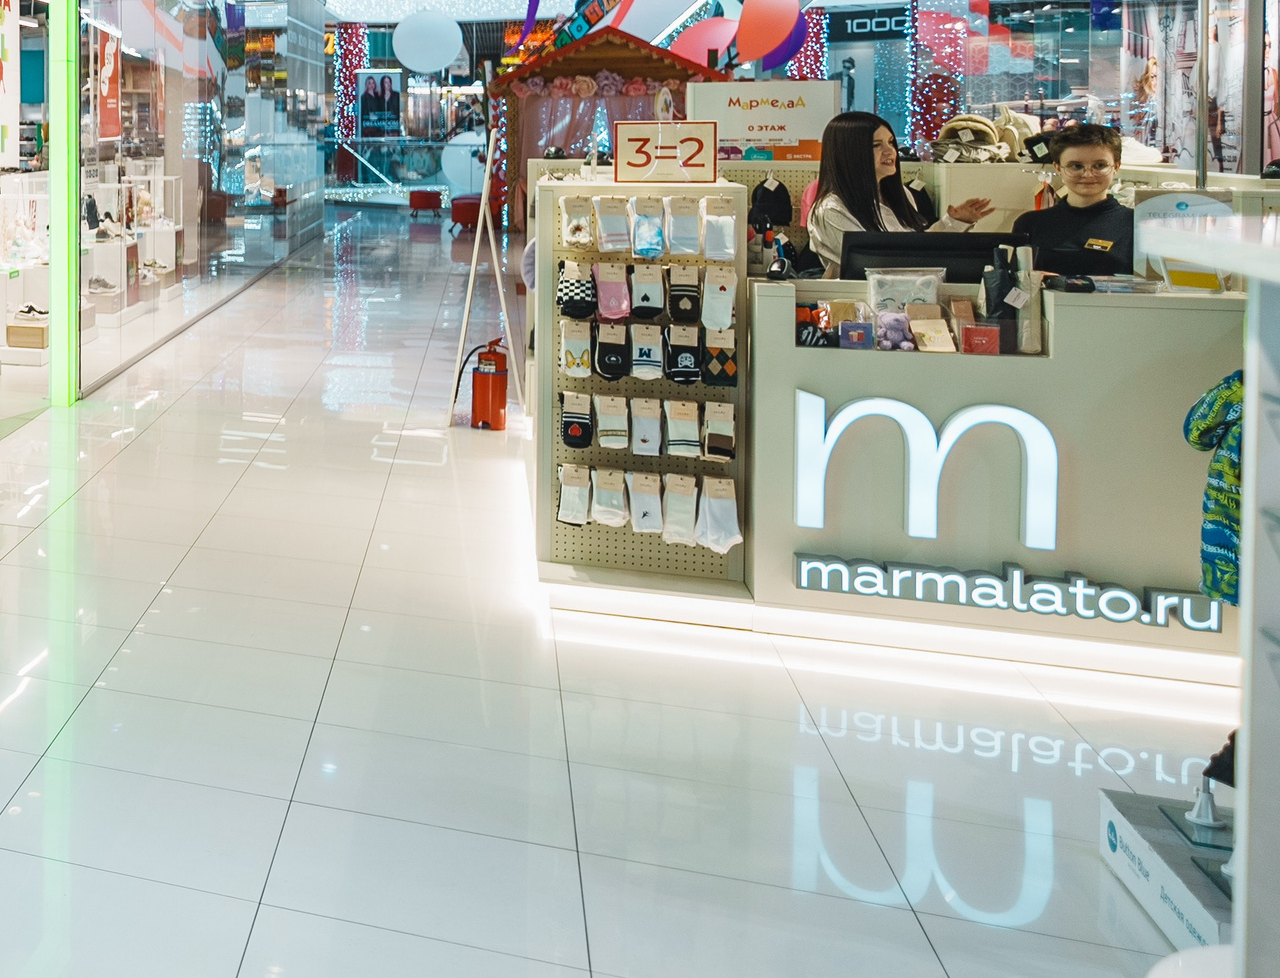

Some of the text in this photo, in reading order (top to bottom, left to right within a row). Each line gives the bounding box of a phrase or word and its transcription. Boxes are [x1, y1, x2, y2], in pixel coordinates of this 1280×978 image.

[757, 124, 787, 132] ЭТАЖ
[626, 136, 705, 168] 3=2
[795, 388, 1059, 551] m
[798, 556, 1221, 632] marmalato.ru
[1118, 834, 1137, 867] Button
[1137, 856, 1150, 882] Blue
[1160, 884, 1185, 924] Детская
